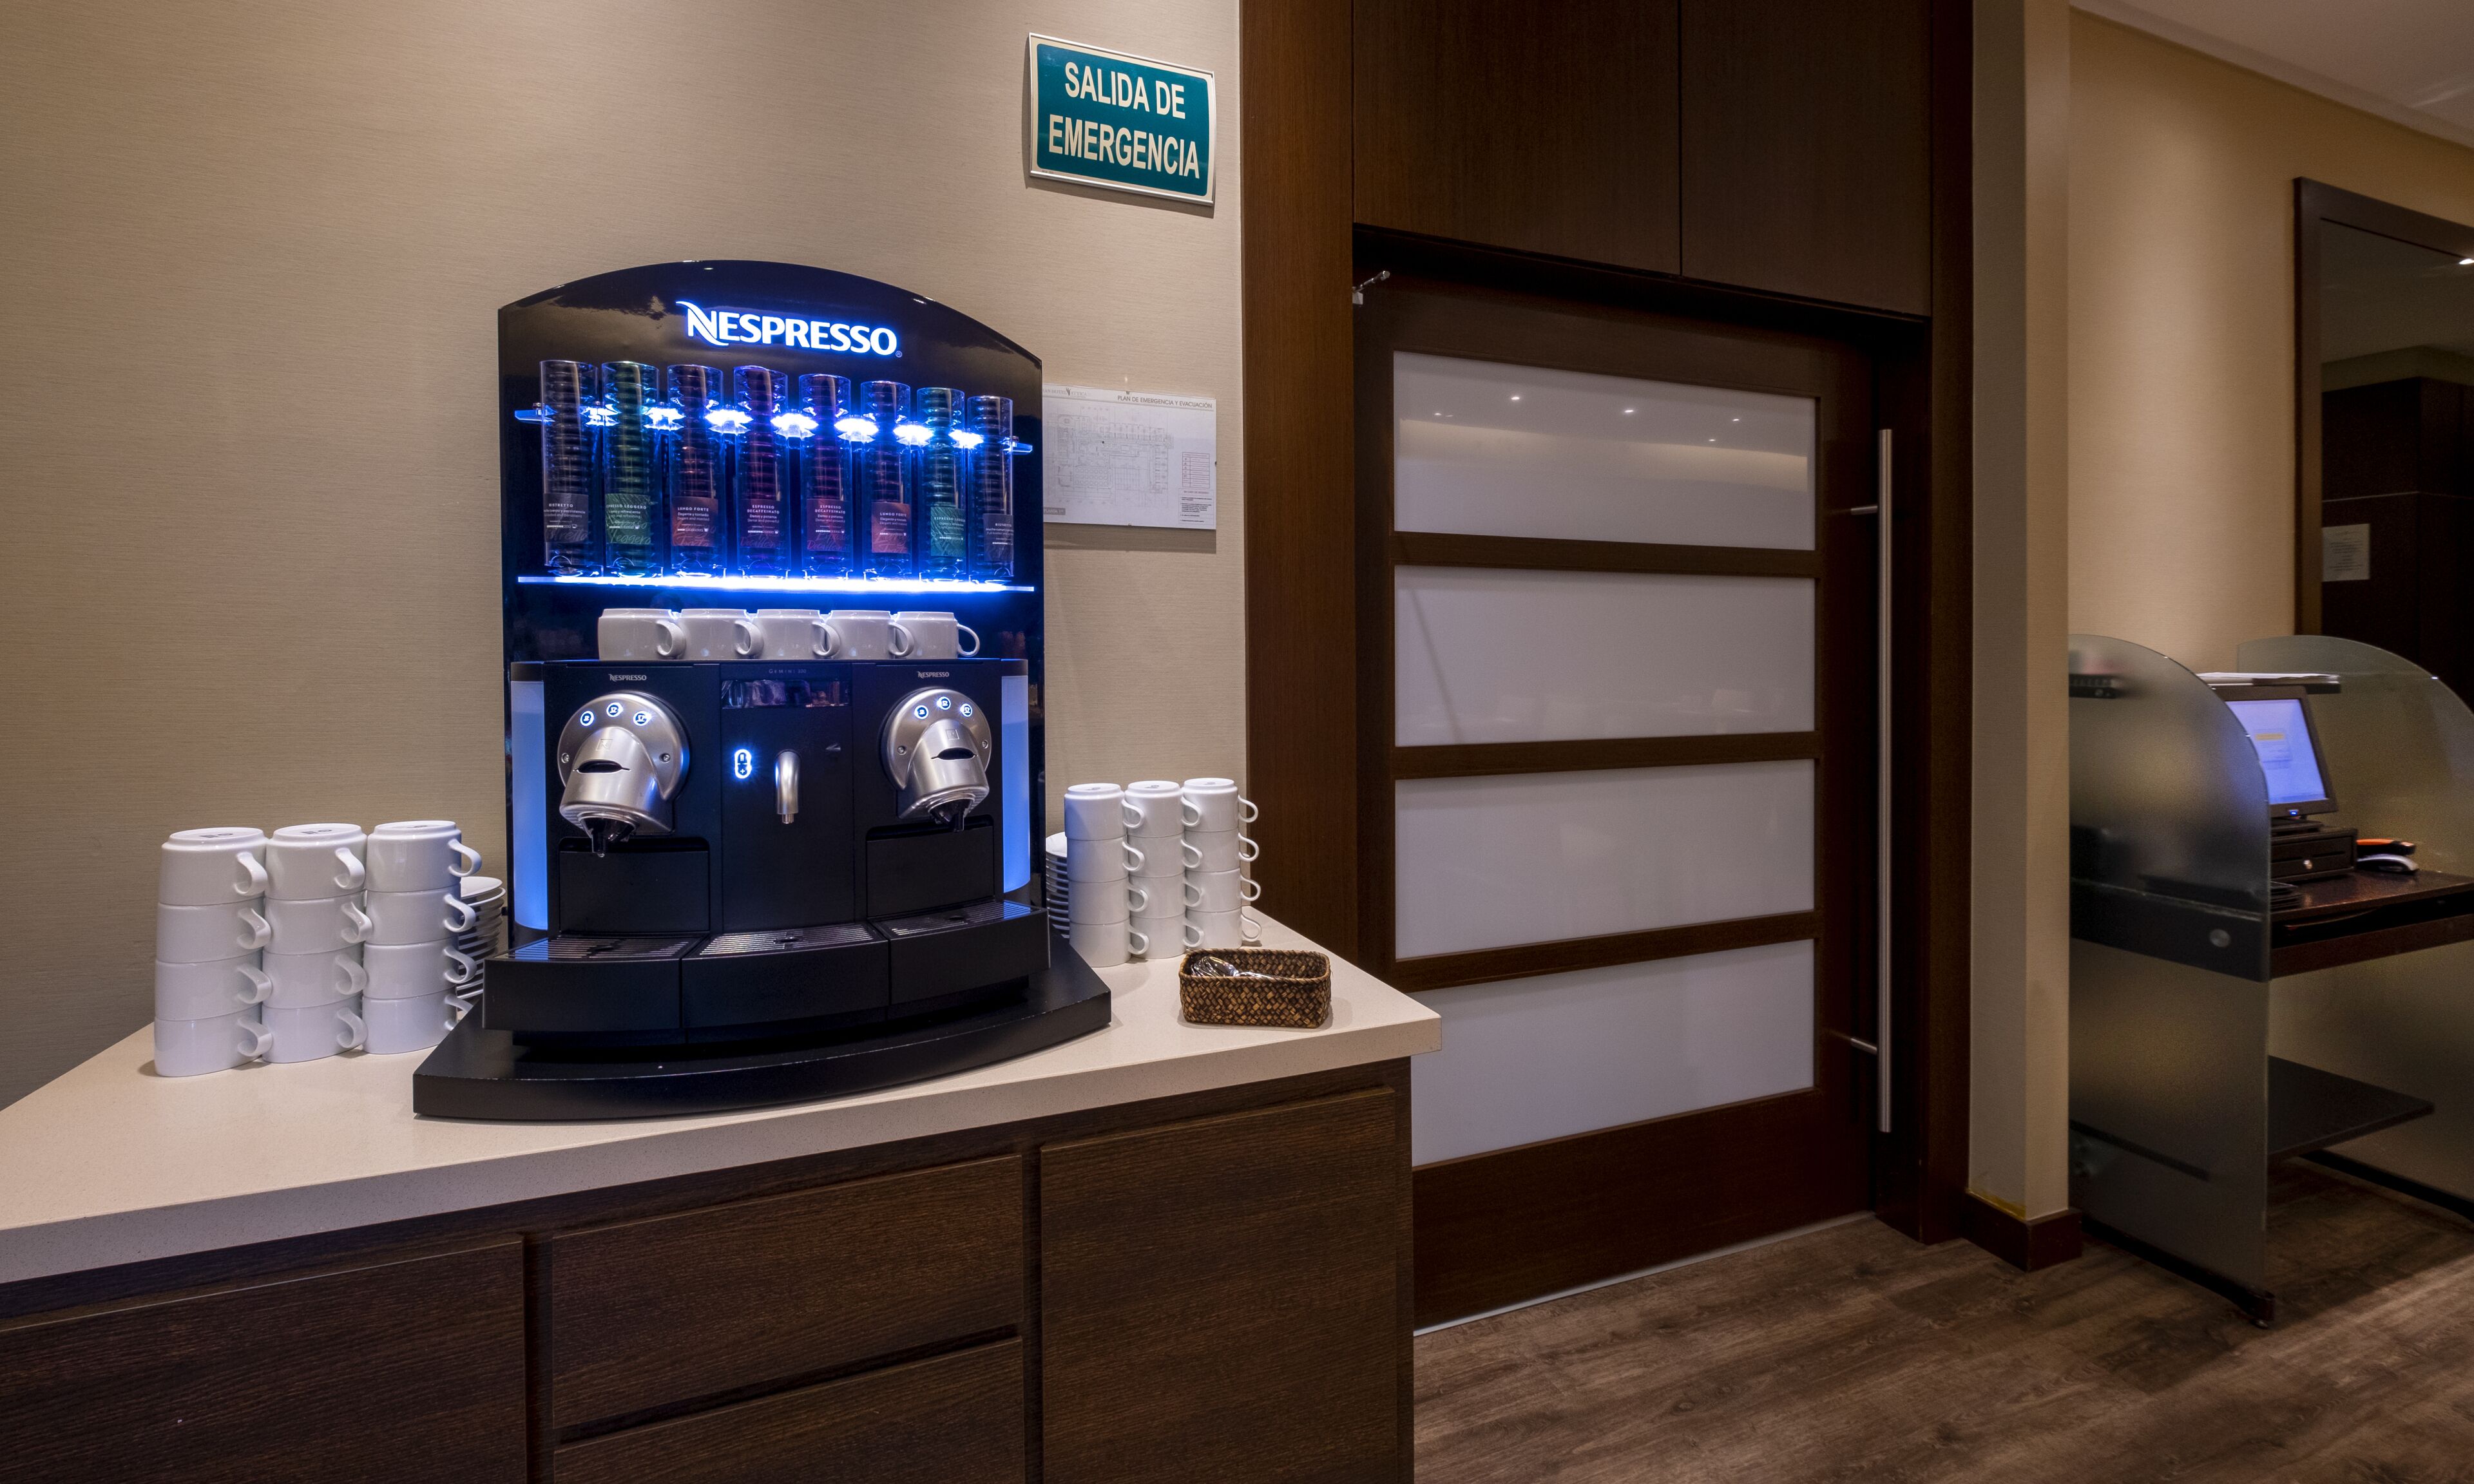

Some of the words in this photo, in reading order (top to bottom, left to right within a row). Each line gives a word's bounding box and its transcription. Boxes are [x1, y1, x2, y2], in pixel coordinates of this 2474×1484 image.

[1065, 62, 1150, 112] SALIDA
[1156, 81, 1185, 119] DE
[1049, 114, 1200, 179] EMERGENCIA
[676, 301, 897, 356] NESPRESSO
[1140, 397, 1174, 406] EMERGENCIA
[608, 673, 647, 682] NESPRESSO
[916, 671, 950, 679] NESPRESSO
